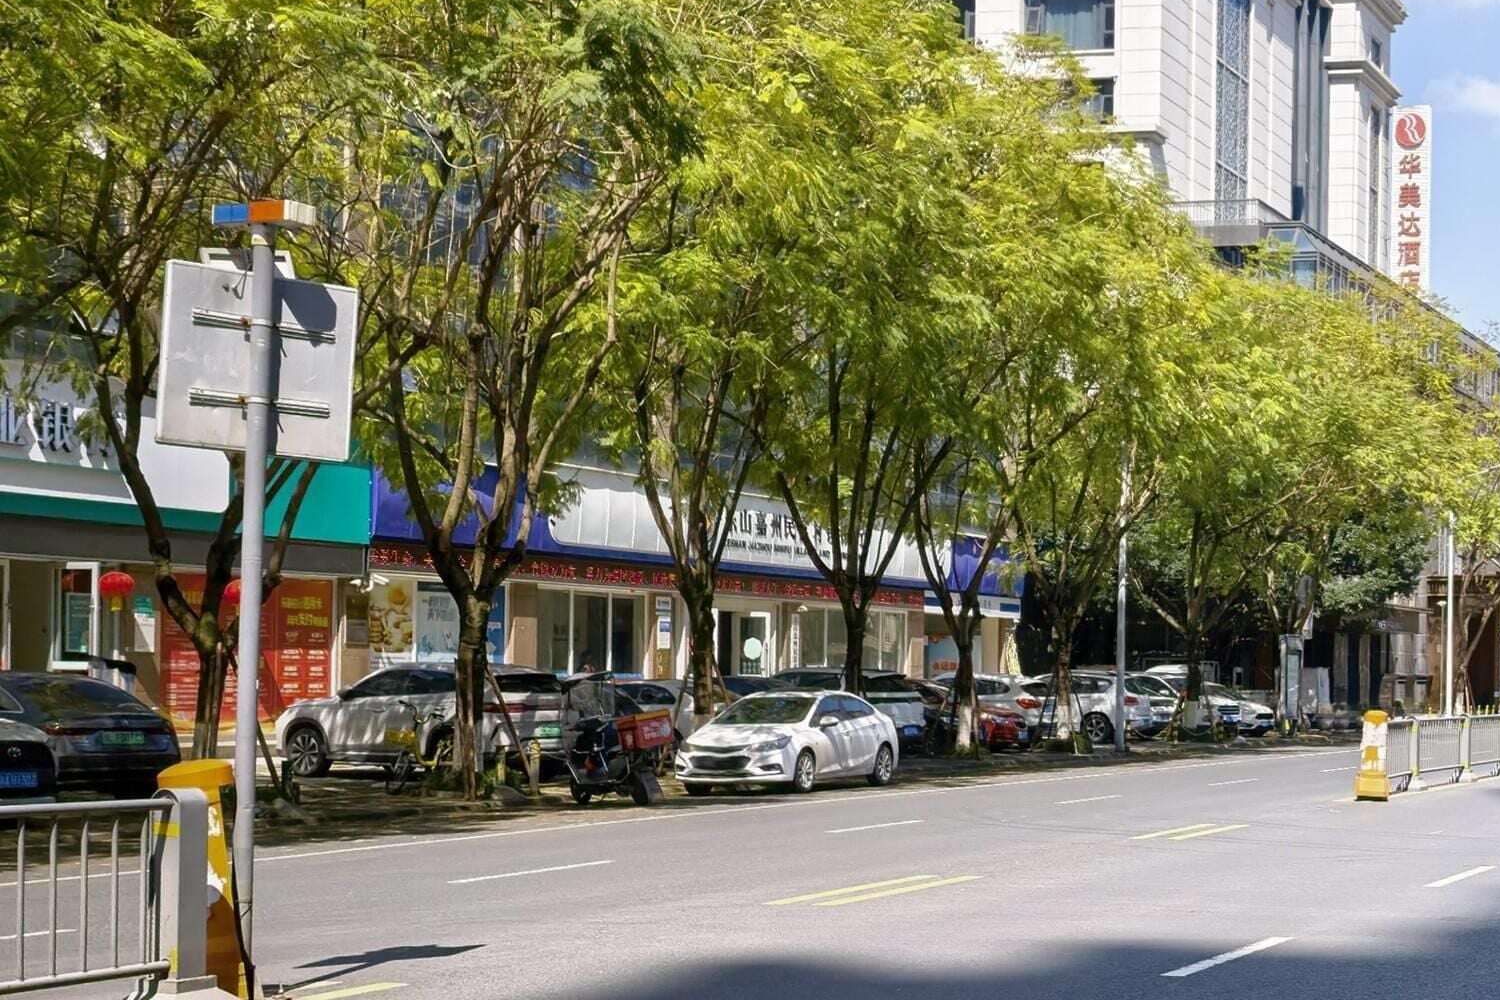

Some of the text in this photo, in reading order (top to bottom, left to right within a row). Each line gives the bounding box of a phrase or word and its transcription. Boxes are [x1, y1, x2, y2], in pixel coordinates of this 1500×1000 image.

[1398, 153, 1422, 289] 华美达酒店
